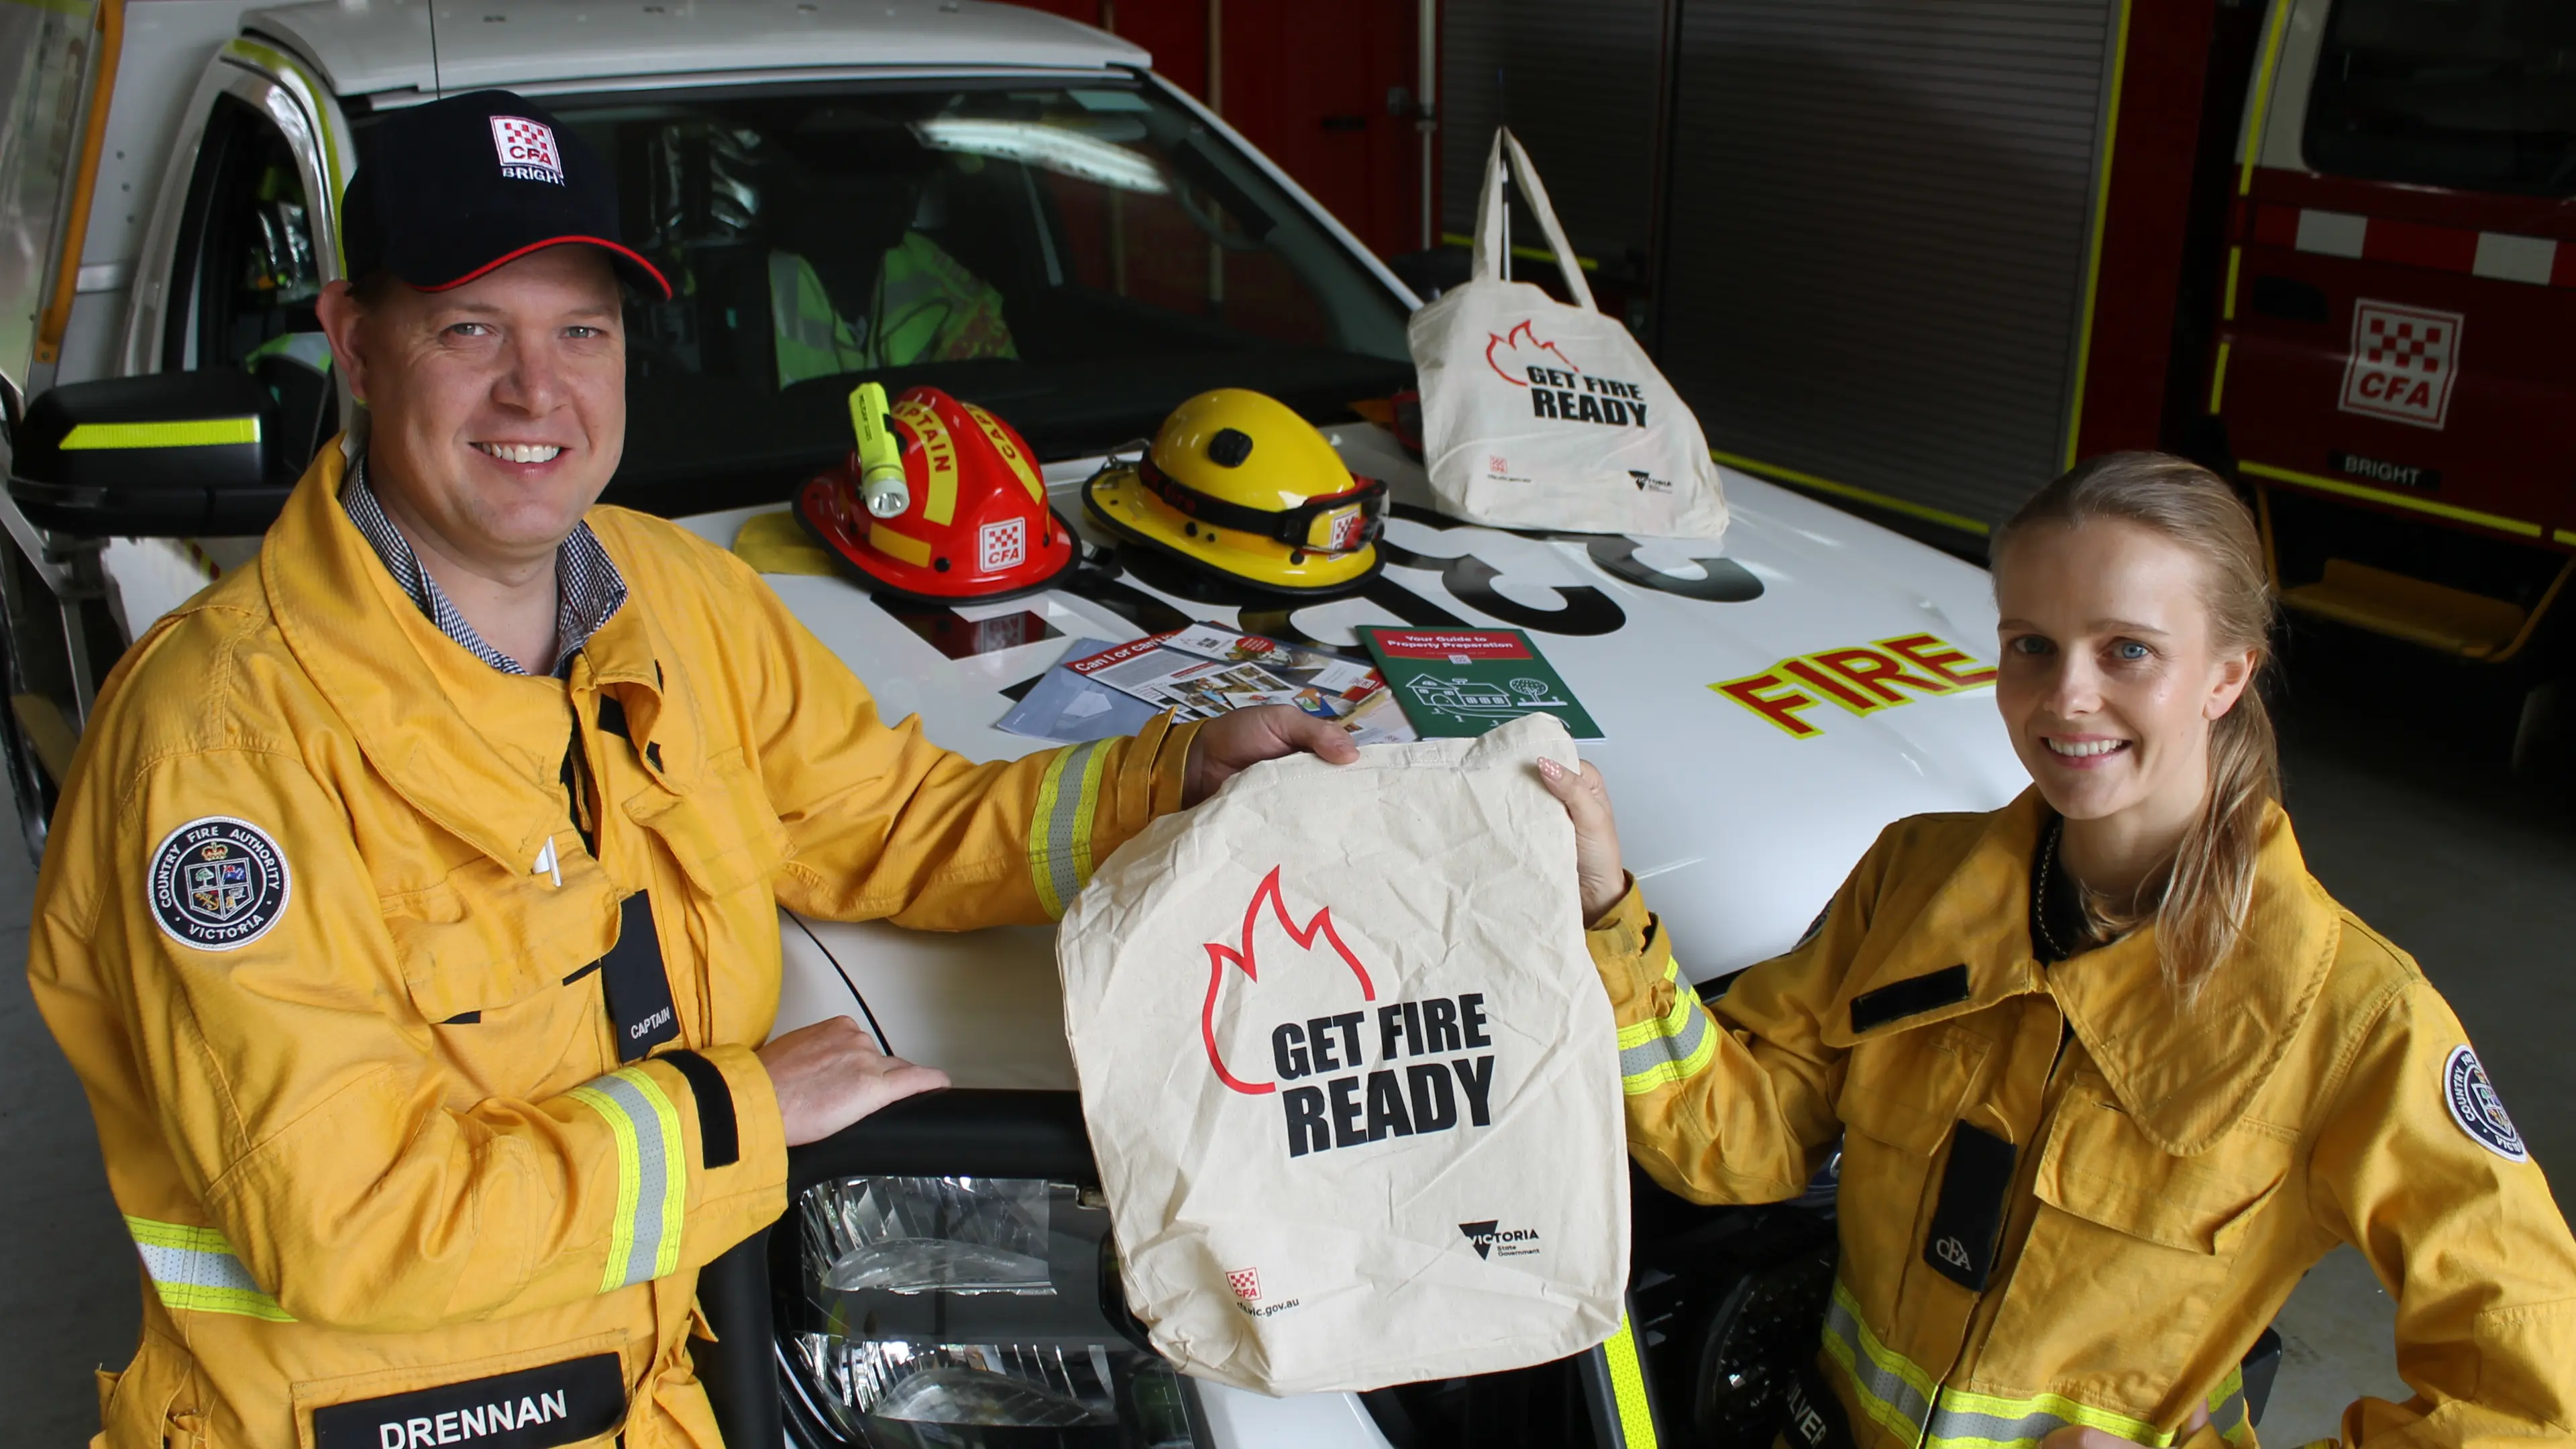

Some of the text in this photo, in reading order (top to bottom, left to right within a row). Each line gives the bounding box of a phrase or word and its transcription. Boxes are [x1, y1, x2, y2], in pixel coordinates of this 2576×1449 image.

[510, 146, 552, 166] CFA
[1527, 365, 1644, 401] GET FIRE
[2359, 372, 2431, 409] CFA
[1531, 388, 1648, 428] READY
[894, 405, 951, 473] APTAIN
[2344, 454, 2421, 486] BRIGHT
[988, 548, 1020, 565] CFA
[1075, 657, 1109, 672] Can
[1114, 648, 1132, 658] or
[1387, 640, 1439, 649] Property
[1706, 632, 1997, 740] FIRE
[158, 826, 280, 908] COUNTRY FIRE AUTHORITY
[189, 914, 264, 939] VICTORIA
[631, 1006, 671, 1039] CAPTAIN
[1272, 993, 1491, 1081] GET FIRE
[1282, 1055, 1495, 1158] READY
[2453, 1065, 2475, 1122] COUNTRY
[1466, 1228, 1540, 1245] VICTORIA
[1498, 1248, 1540, 1257] Government
[1235, 1287, 1257, 1298] CFA
[379, 1389, 568, 1449] DRENNAN
